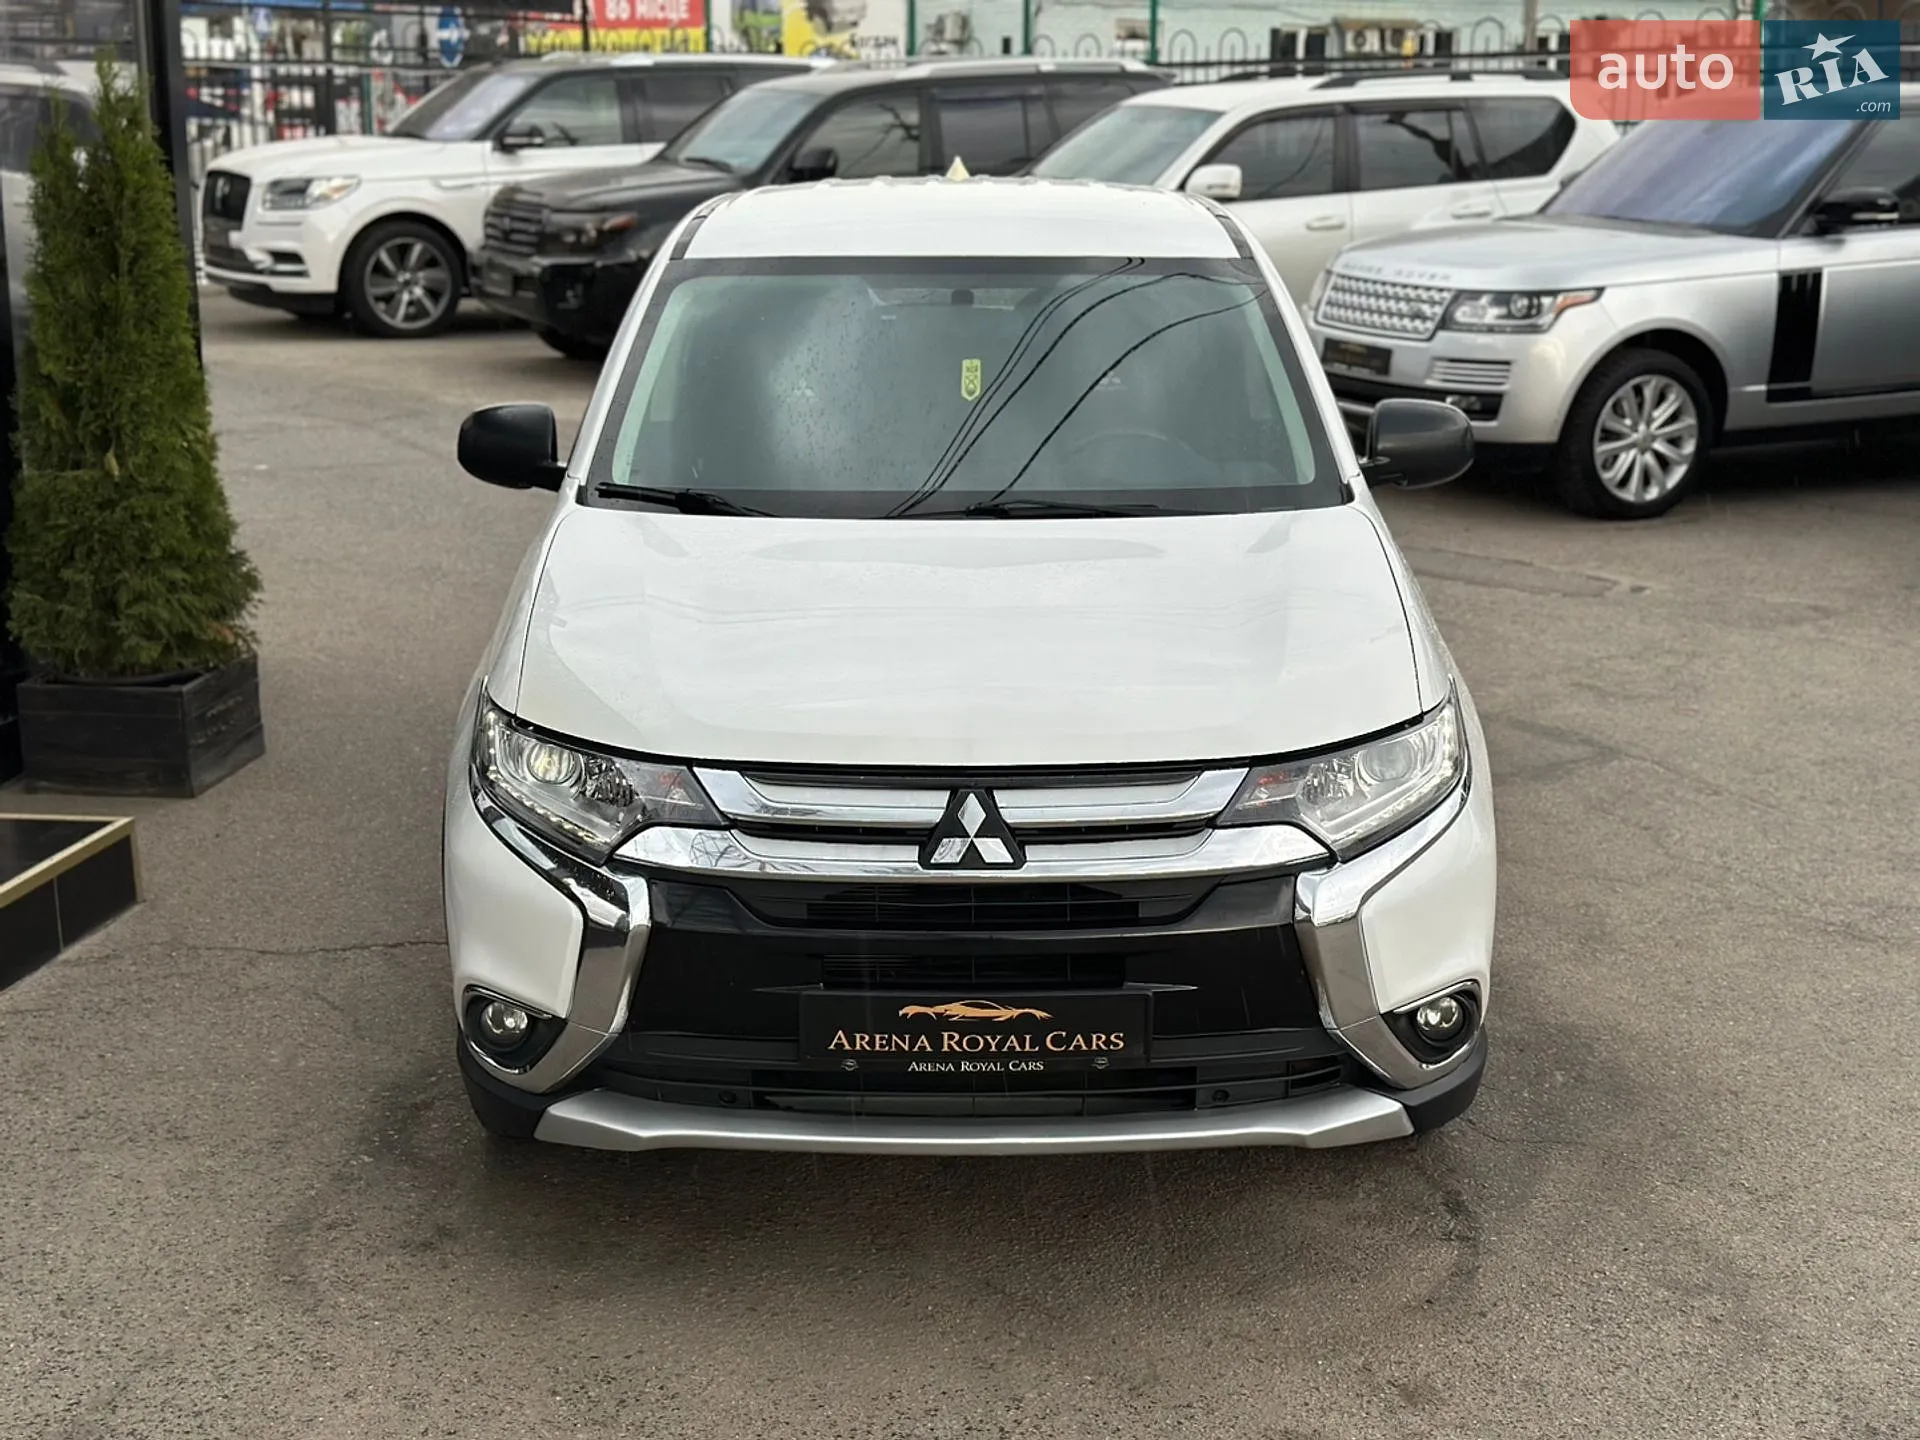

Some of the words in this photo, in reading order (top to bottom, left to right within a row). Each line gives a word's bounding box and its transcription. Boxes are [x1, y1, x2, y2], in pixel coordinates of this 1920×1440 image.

[828, 1029, 932, 1052] ARENA
[941, 1031, 1039, 1052] ROYAL
[1045, 1030, 1125, 1052] CARS
[908, 1060, 955, 1072] ARENA
[960, 1060, 1005, 1072] ROYAL
[1009, 1060, 1044, 1072] CARS
